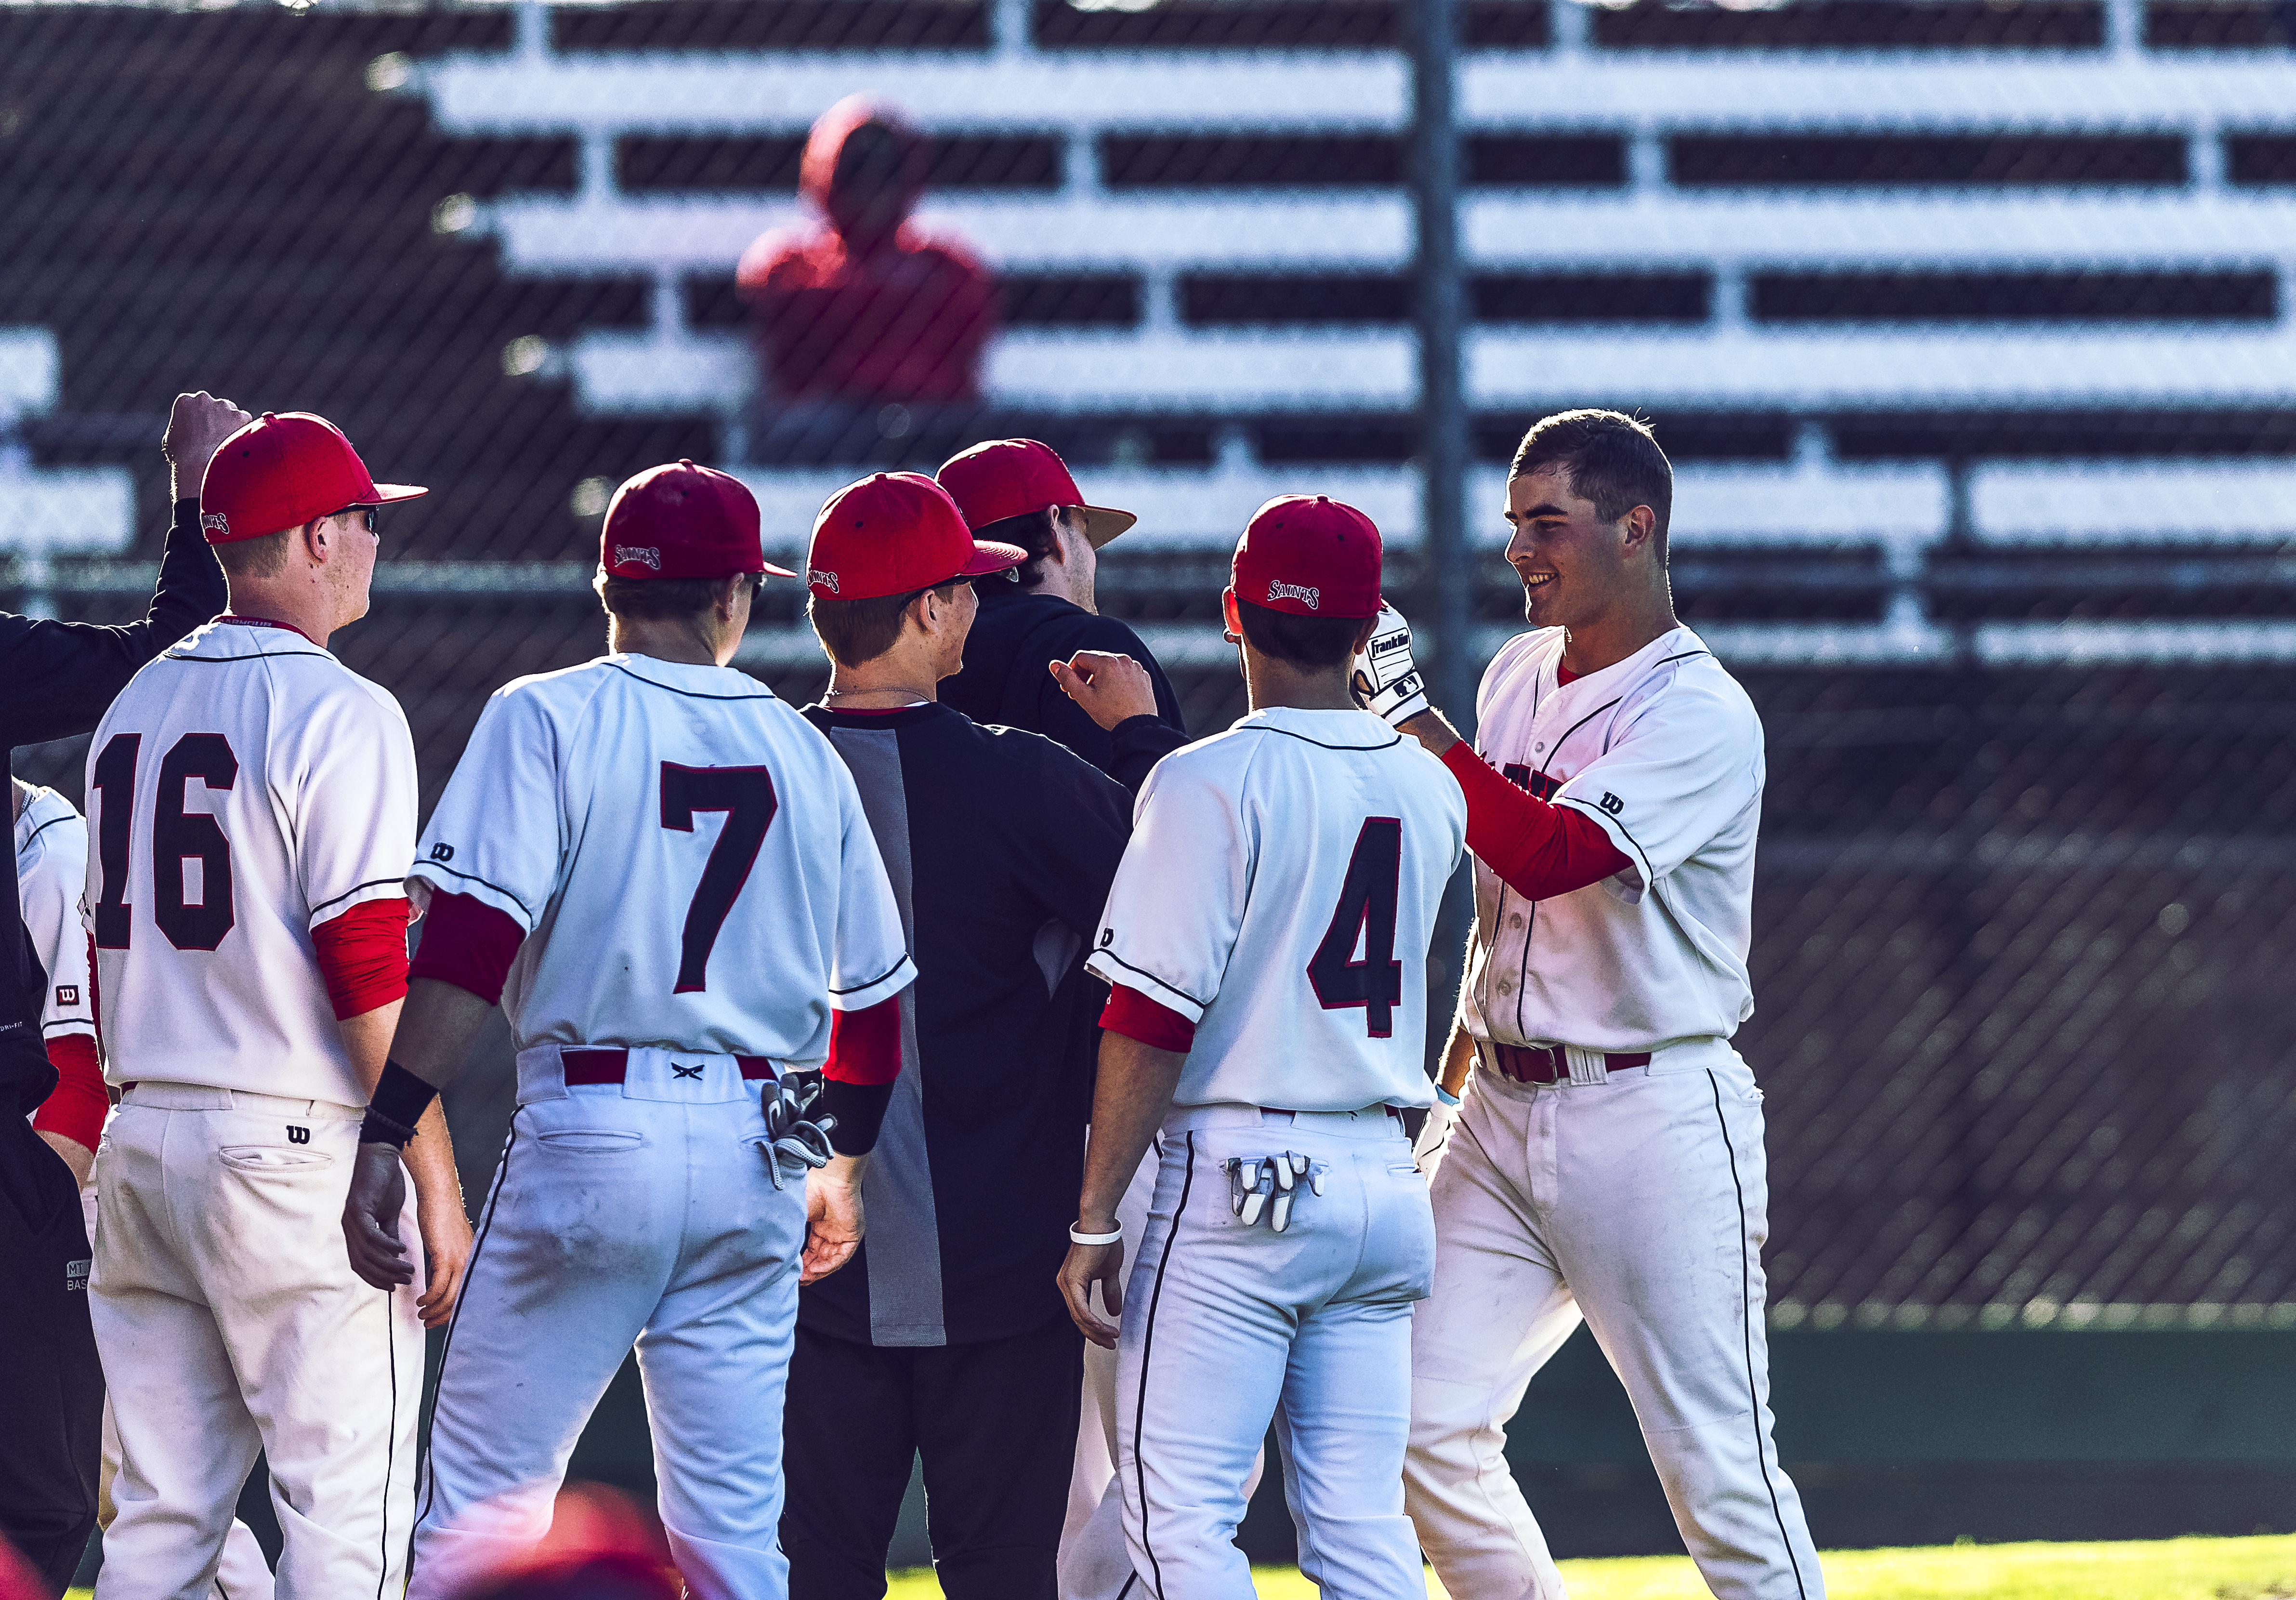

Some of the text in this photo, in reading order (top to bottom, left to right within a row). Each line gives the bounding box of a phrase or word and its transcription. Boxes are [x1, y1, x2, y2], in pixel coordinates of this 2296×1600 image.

[615, 544, 661, 570] SAINTS
[1267, 580, 1319, 609] SAINTS
[1371, 634, 1408, 658] Franklin
[92, 732, 239, 952] 16
[660, 760, 778, 994] 7
[1306, 816, 1402, 1038] 4
[0, 1021, 22, 1031] DRI-FIT
[68, 1262, 83, 1275] MT
